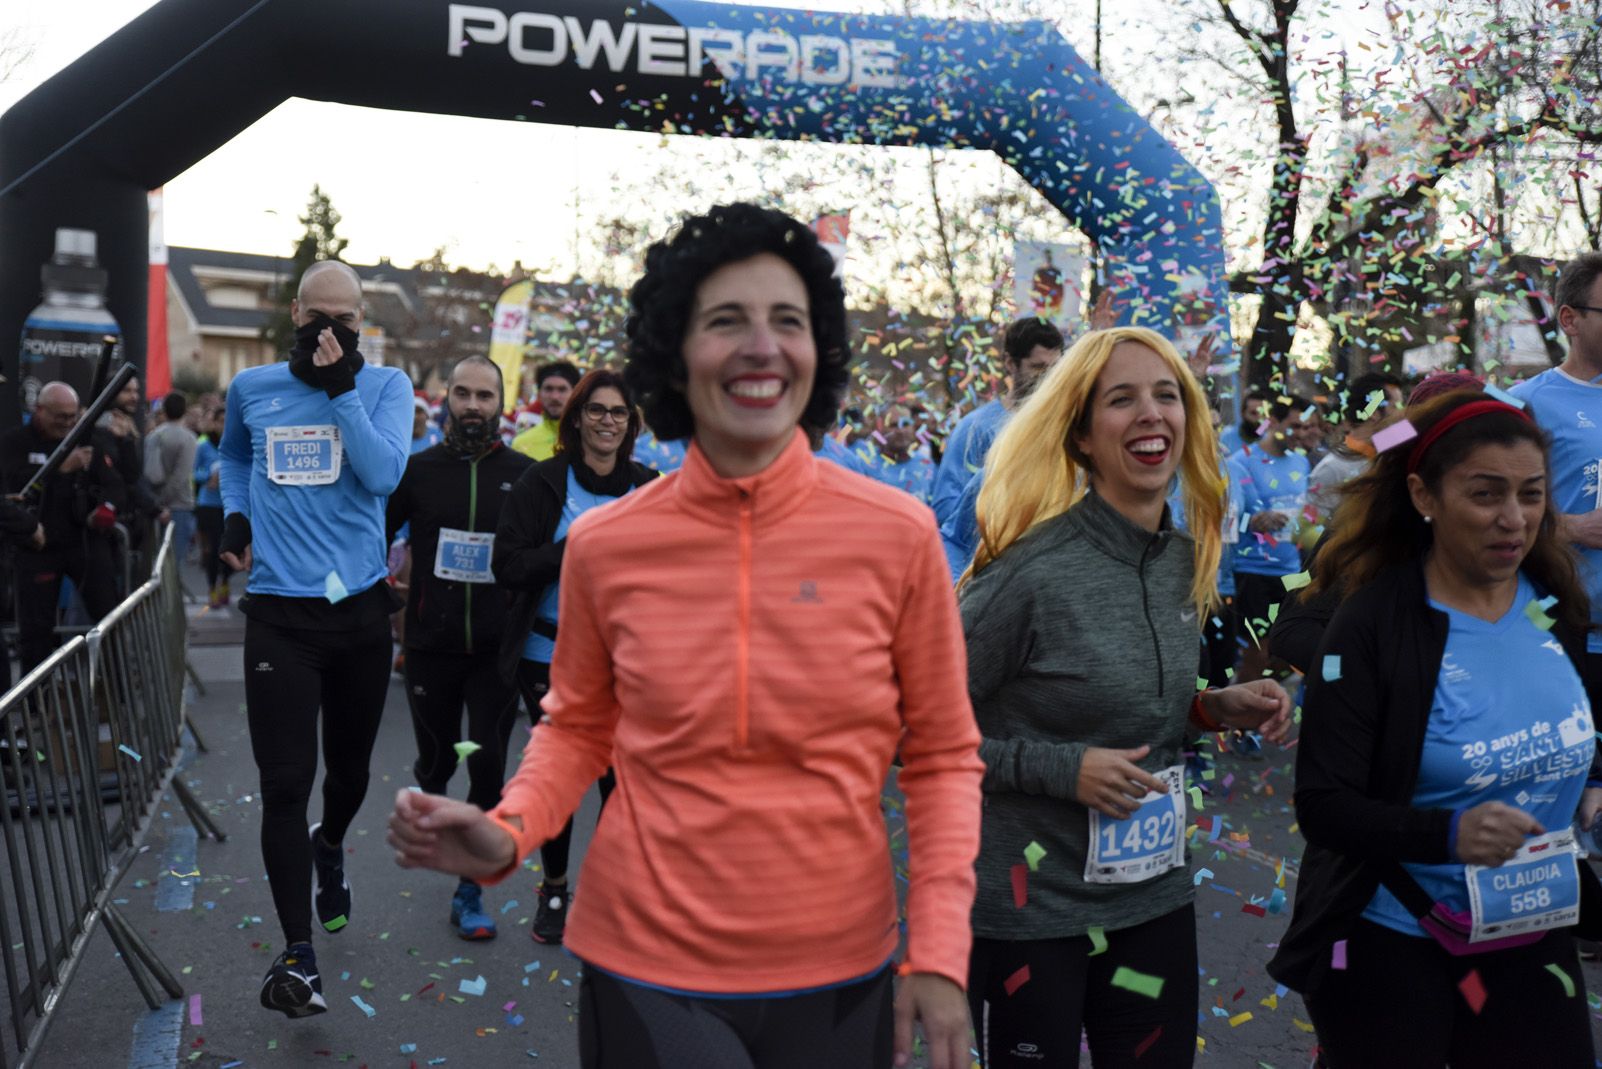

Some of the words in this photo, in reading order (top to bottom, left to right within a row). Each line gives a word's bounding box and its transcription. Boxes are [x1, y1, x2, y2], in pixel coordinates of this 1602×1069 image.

[447, 3, 898, 88] POWERADE
[23, 338, 123, 359] POWERAE
[284, 442, 321, 455] FREDI
[287, 456, 320, 469] 1496
[1462, 741, 1487, 760] 20
[1491, 728, 1529, 752] anys
[1531, 720, 1551, 737] de
[1101, 811, 1175, 858] 1432
[1493, 862, 1562, 891] CLAUDIA
[1511, 887, 1551, 914] 558
